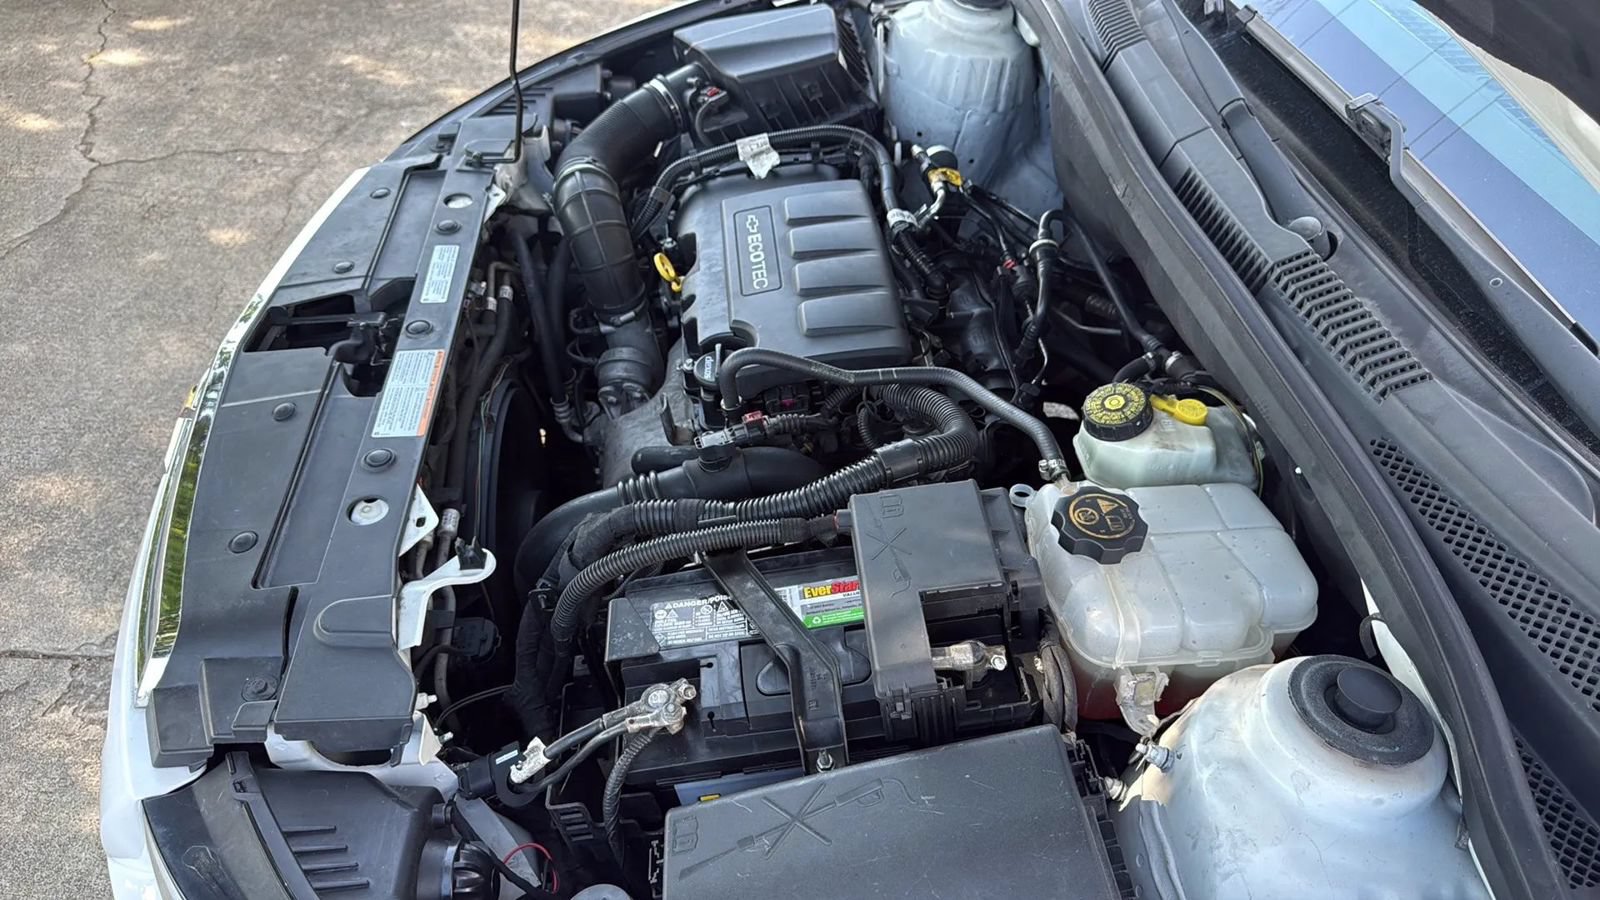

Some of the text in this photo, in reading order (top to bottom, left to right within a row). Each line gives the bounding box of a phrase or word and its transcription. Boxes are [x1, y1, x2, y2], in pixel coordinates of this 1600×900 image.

[747, 233, 768, 289] ECOTEC
[803, 580, 860, 599] EverStar
[673, 595, 731, 608] DANGER/POIS
